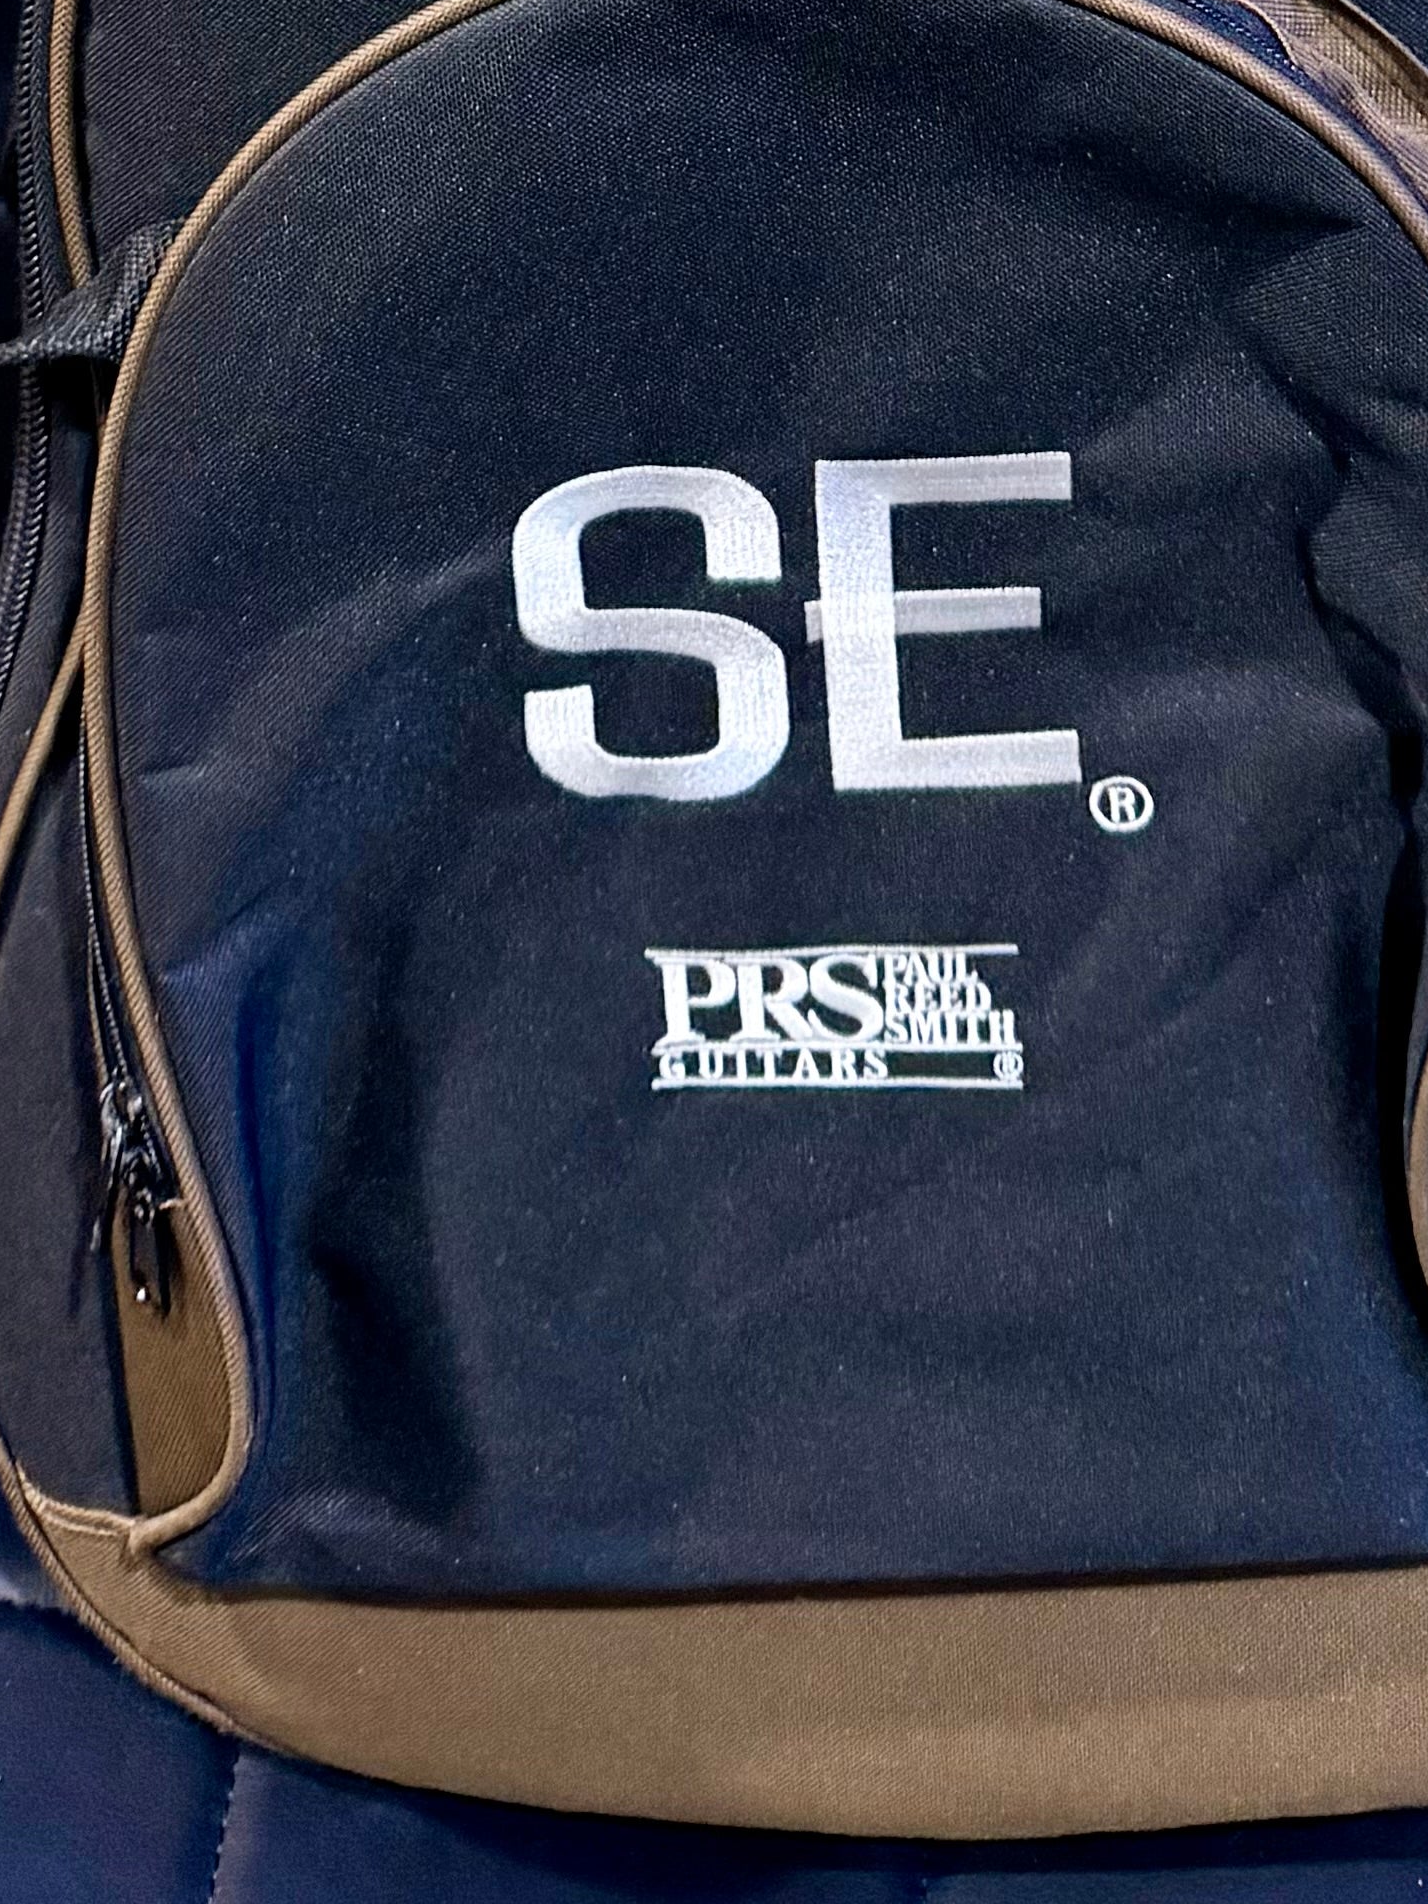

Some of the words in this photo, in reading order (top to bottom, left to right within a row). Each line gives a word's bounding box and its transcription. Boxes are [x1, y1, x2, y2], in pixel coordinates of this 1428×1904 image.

[512, 450, 1084, 803] SE
[883, 952, 979, 986] PAUL
[652, 953, 885, 1046] PRS
[883, 980, 993, 1014] REED
[883, 1008, 1015, 1046] SMITH
[657, 1048, 889, 1080] GUITARS
